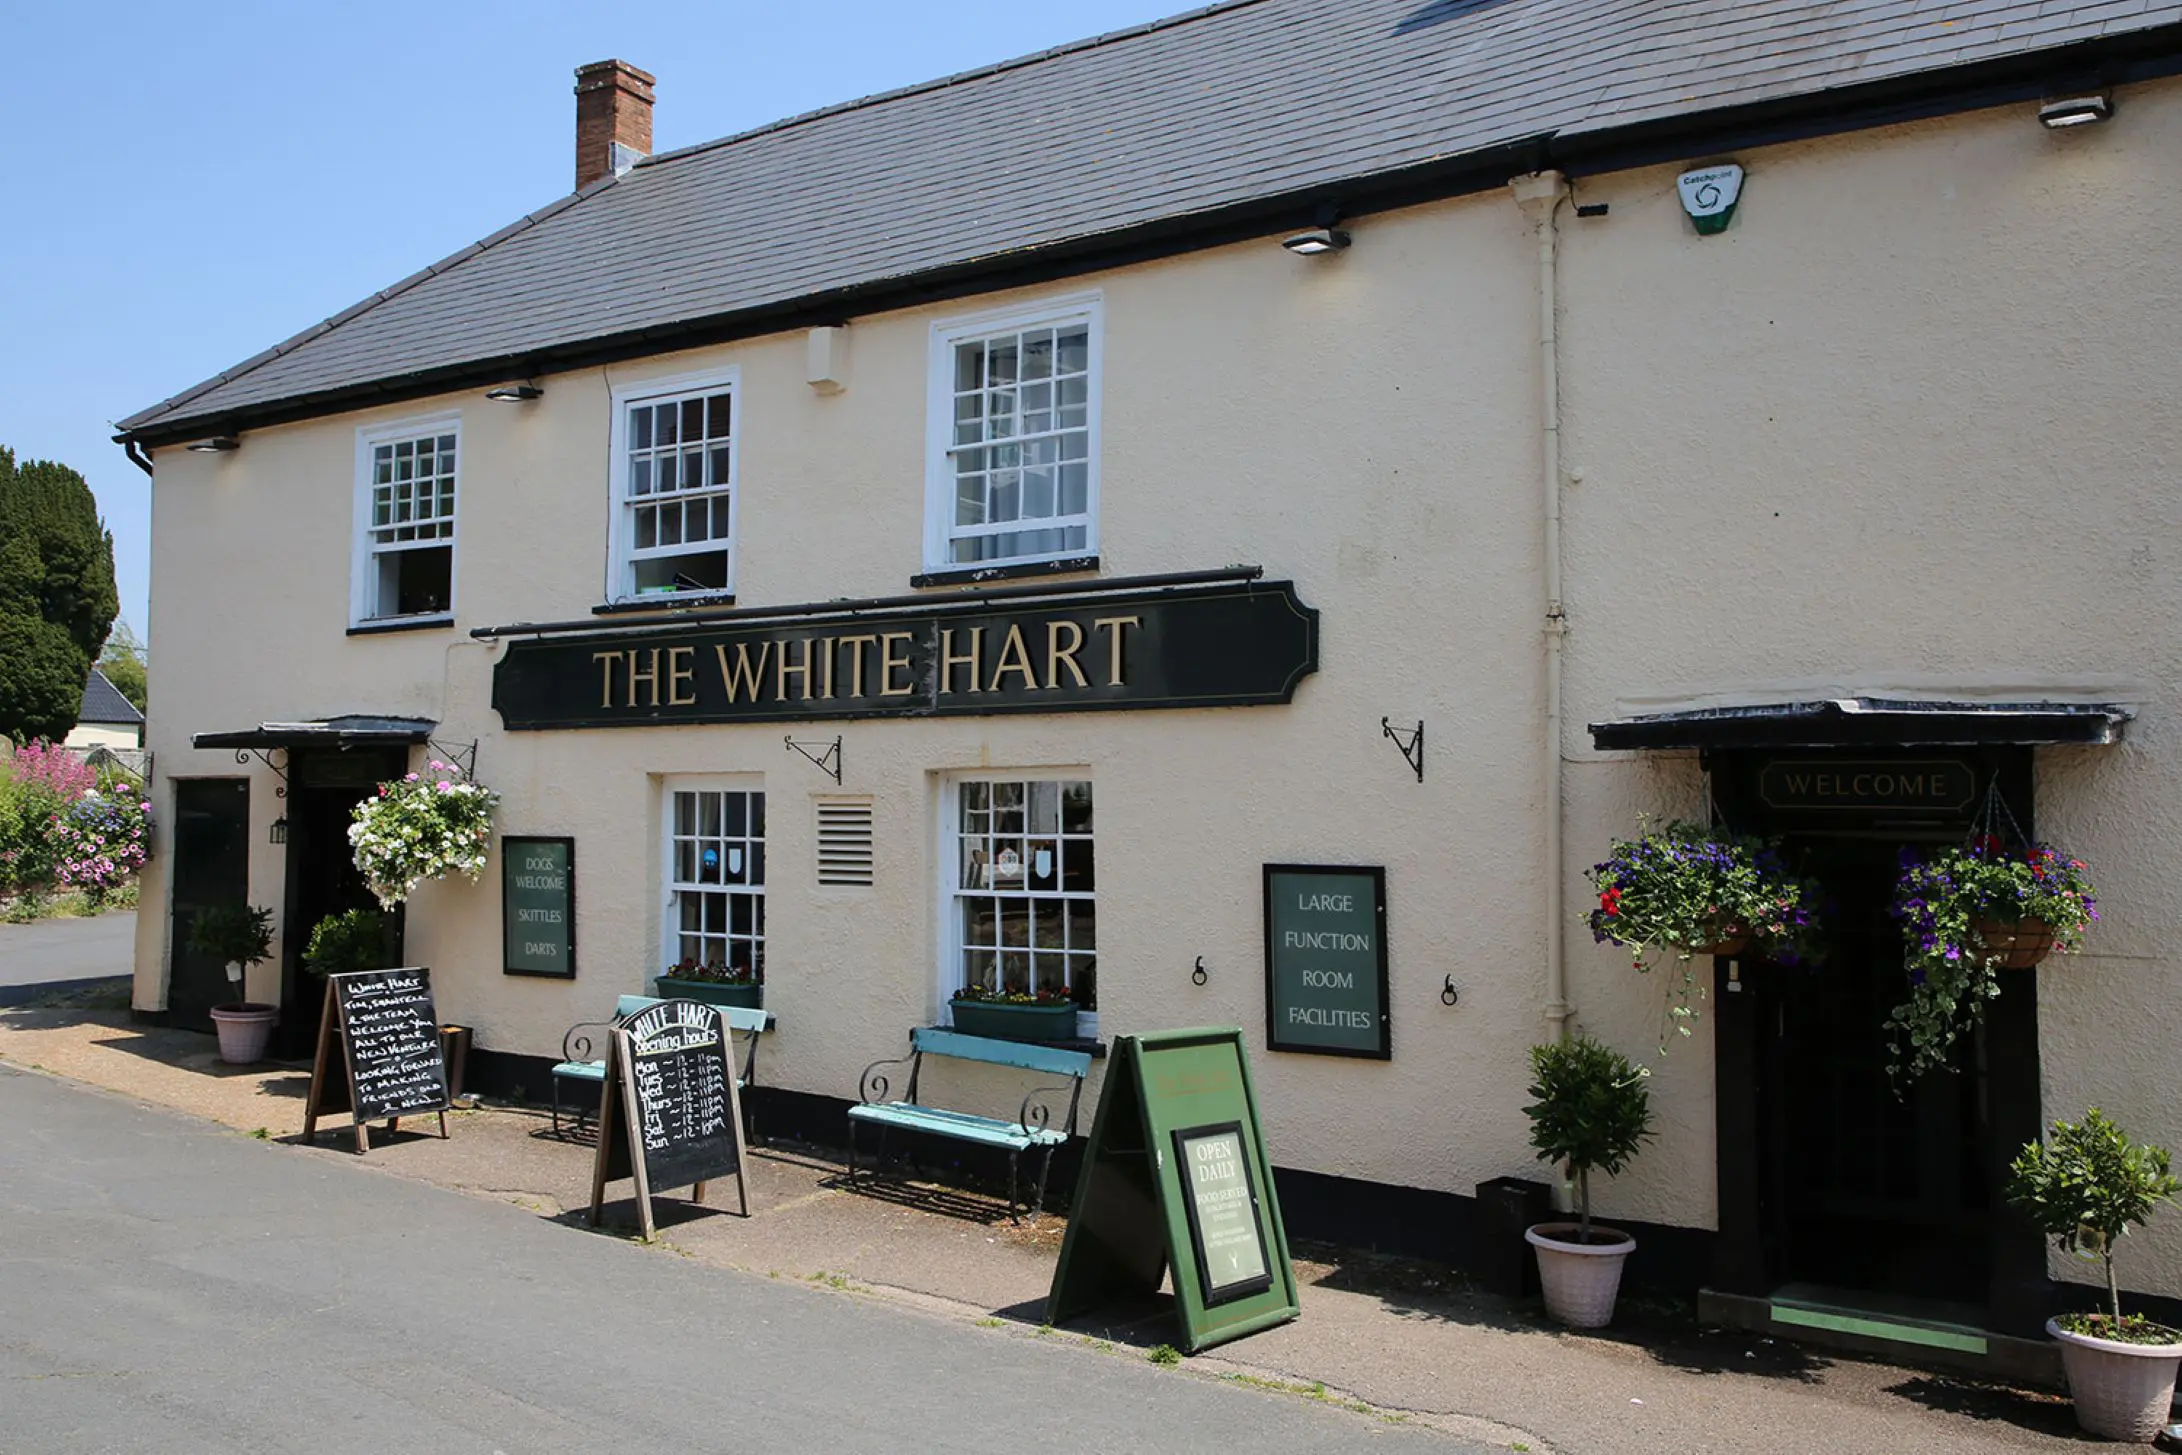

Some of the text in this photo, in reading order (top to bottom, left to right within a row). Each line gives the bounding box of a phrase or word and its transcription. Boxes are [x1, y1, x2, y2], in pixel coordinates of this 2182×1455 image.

[592, 615, 1141, 708] THE WHITE HART
[1785, 774, 1947, 796] WELCOME
[525, 857, 554, 870] DOGS
[516, 875, 565, 889] WELCOME
[1298, 893, 1353, 912] LARGE
[519, 908, 562, 923] SKITTLES
[525, 942, 557, 956] DARTS
[1285, 931, 1369, 951] FUNCTION
[1302, 970, 1353, 989] ROOM
[677, 1003, 717, 1031] HART
[1289, 1007, 1371, 1028] FACILITIES
[683, 1027, 718, 1045] hours
[1196, 1140, 1232, 1161] OPEN
[1199, 1161, 1236, 1182] DAILY
